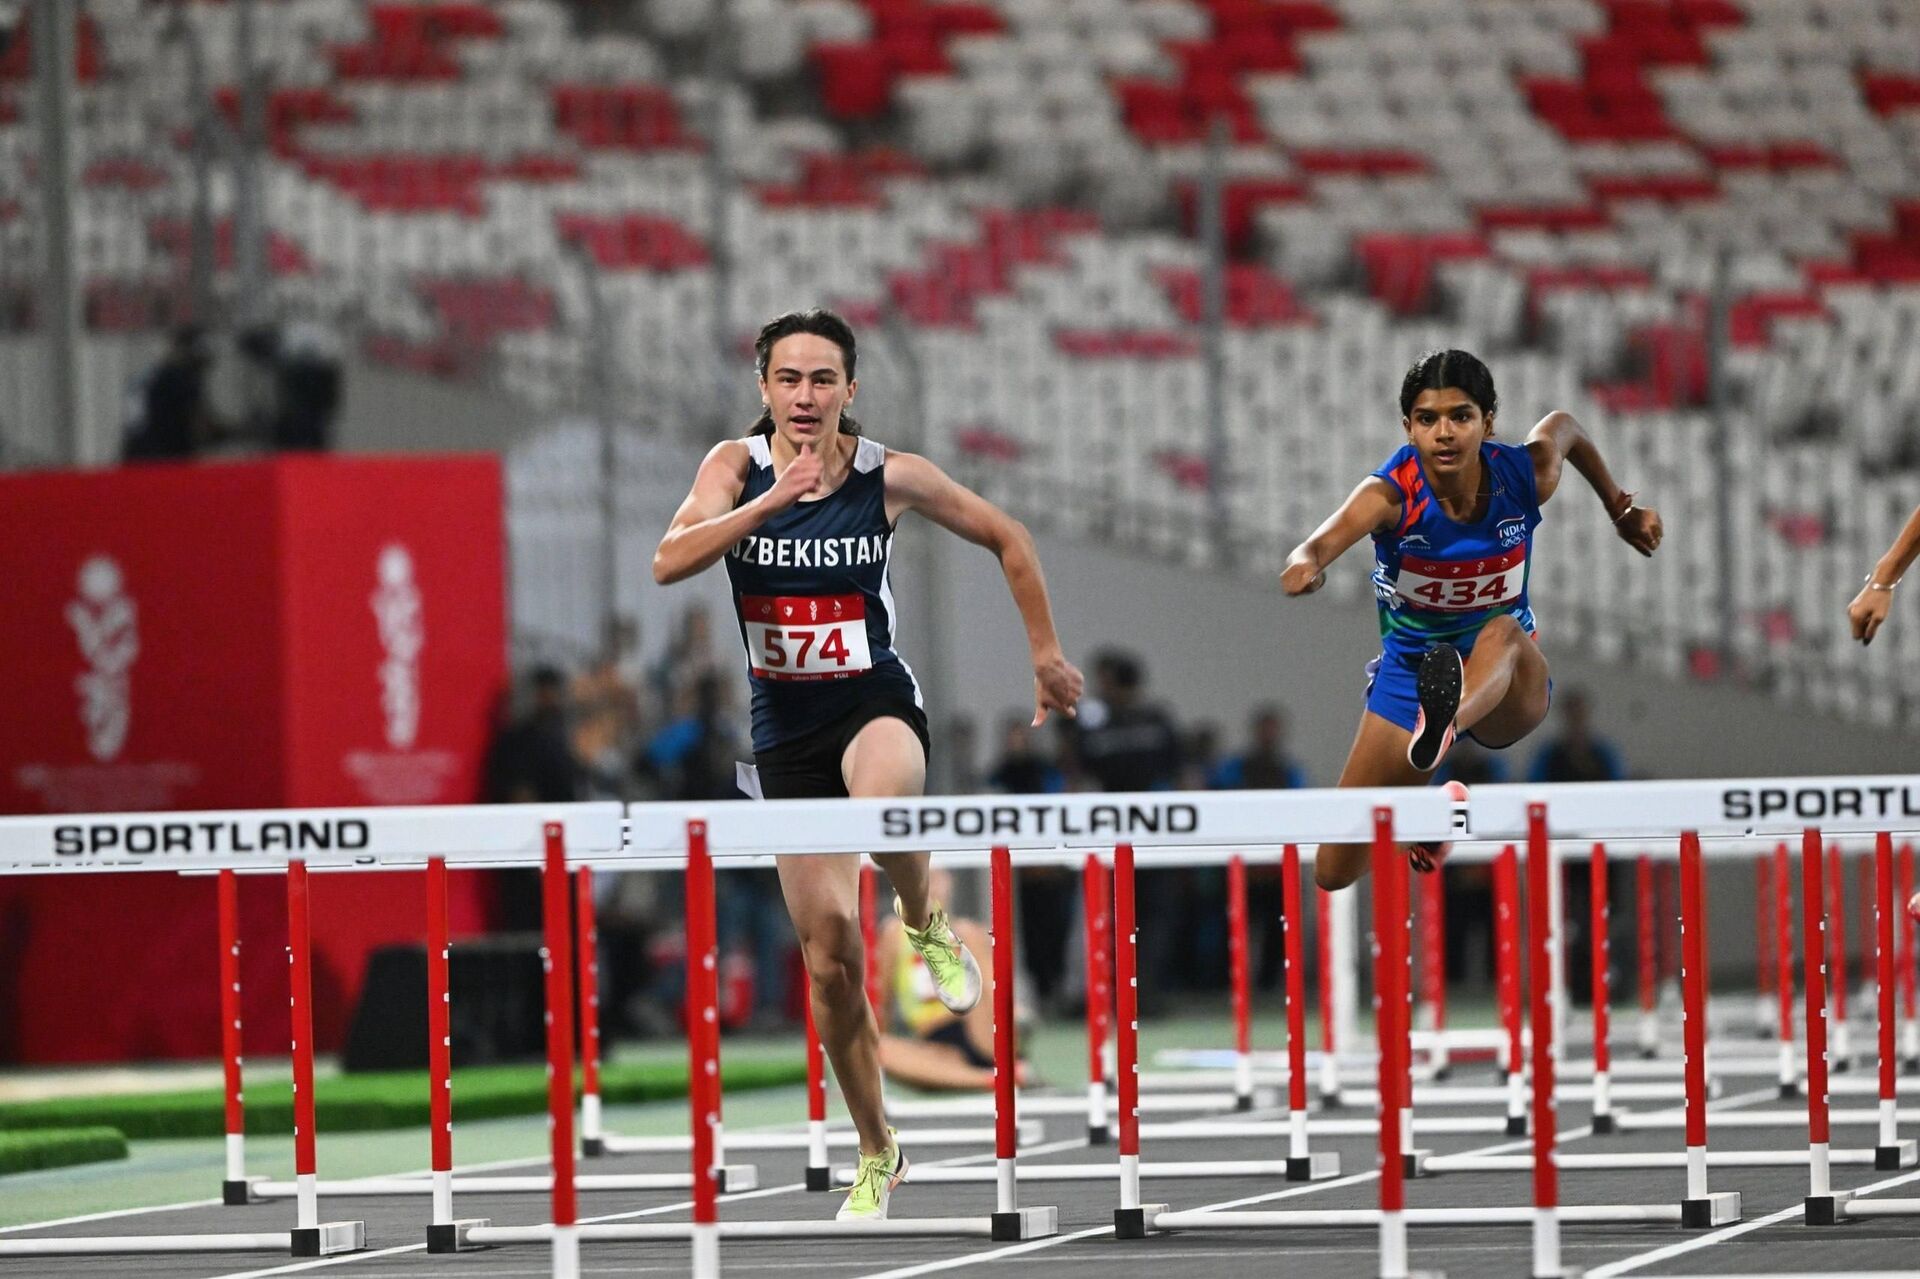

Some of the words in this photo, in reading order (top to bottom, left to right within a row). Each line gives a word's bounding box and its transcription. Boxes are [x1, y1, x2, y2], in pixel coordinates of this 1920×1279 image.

[1500, 523, 1526, 539] INDIA
[1414, 575, 1508, 606] 434
[764, 628, 850, 668] 574
[1722, 786, 1920, 819] SPORTL
[881, 804, 1198, 838] SPORTLAND
[54, 820, 370, 856] SPORTLAND
